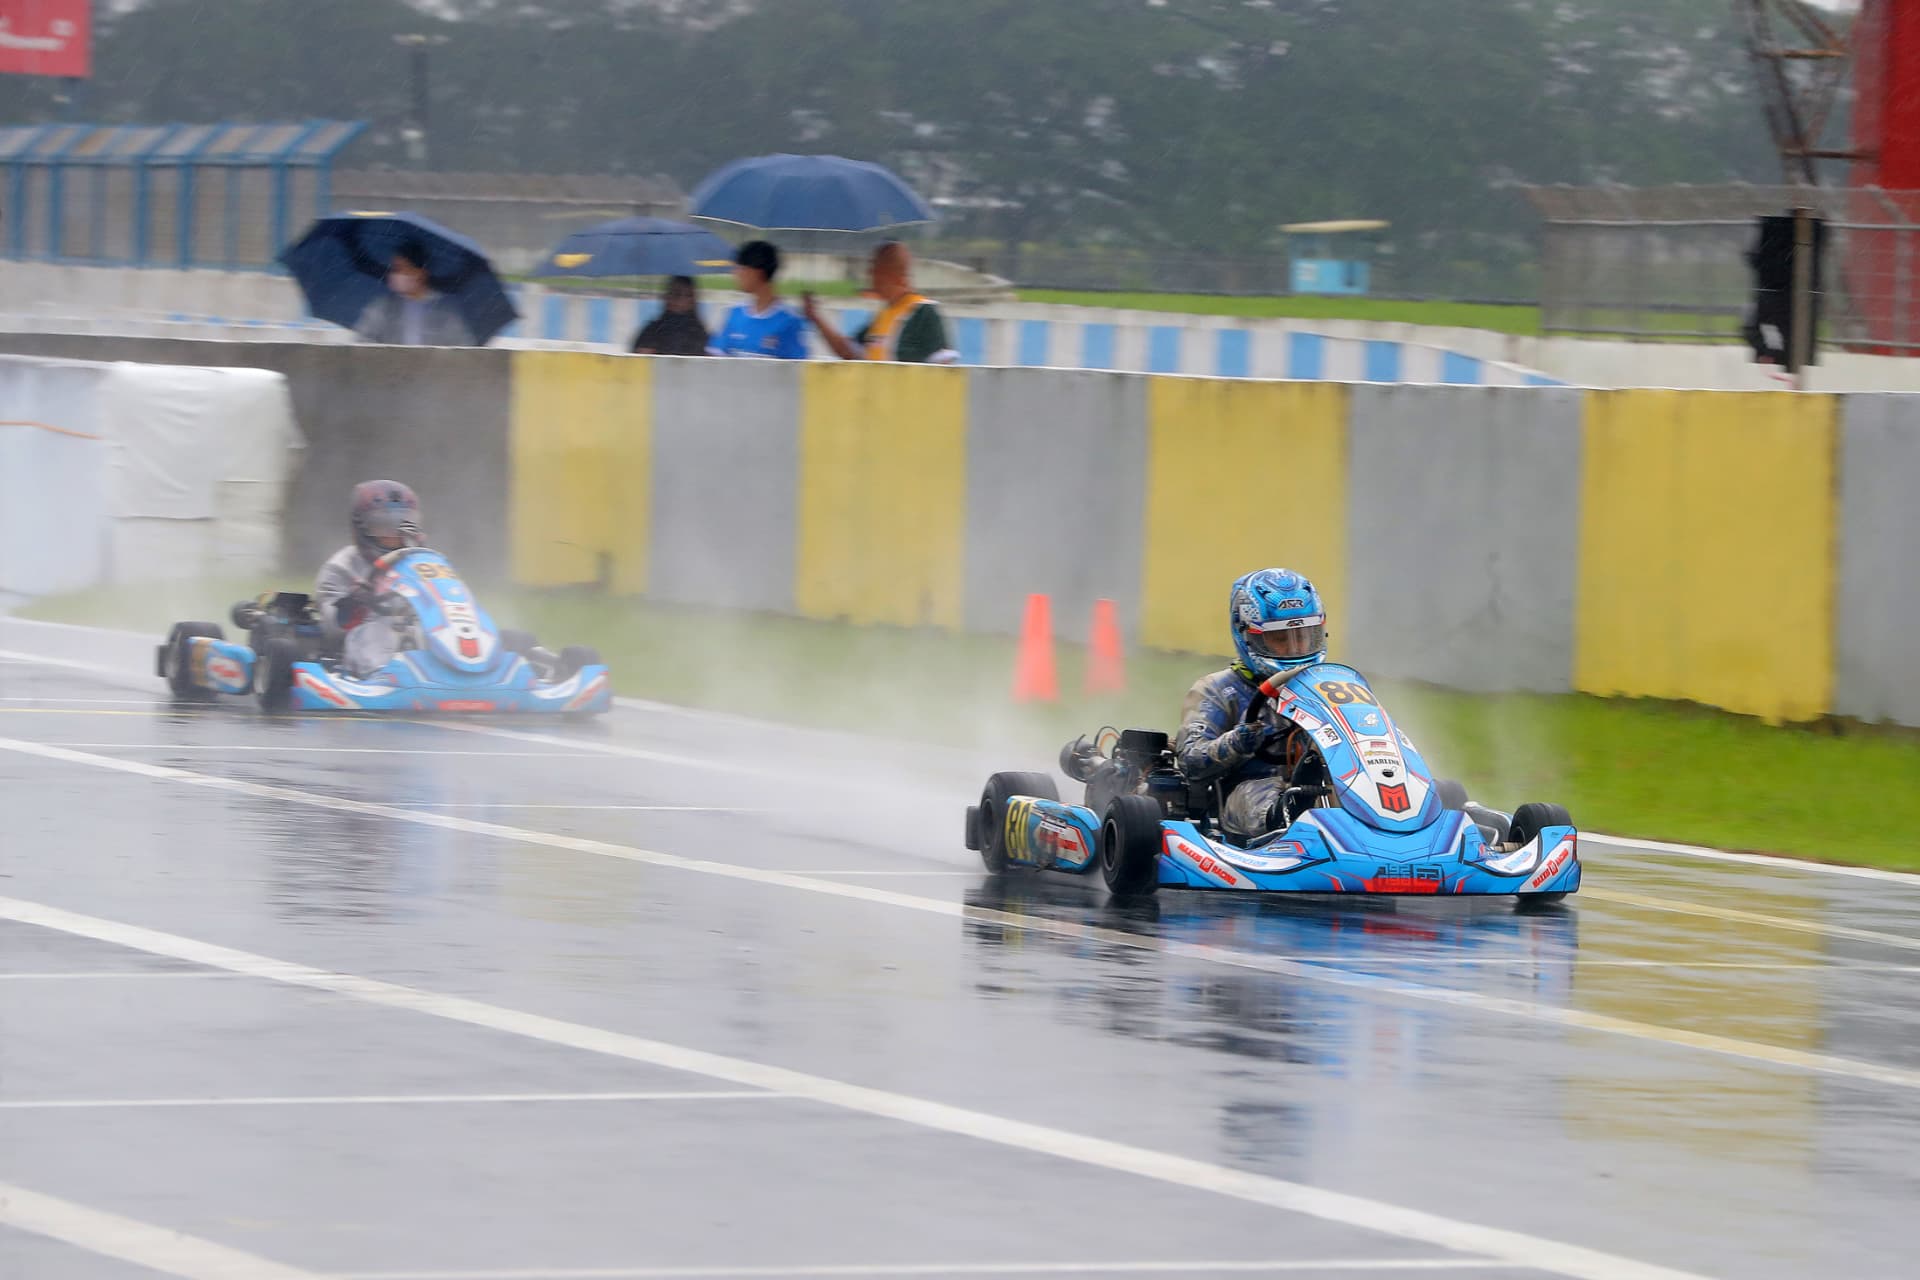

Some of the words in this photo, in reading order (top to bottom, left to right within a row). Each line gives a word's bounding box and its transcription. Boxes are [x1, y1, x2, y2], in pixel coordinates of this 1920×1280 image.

[1320, 681, 1378, 706] 80
[1006, 800, 1031, 860] 80
[1210, 865, 1238, 886] RACING
